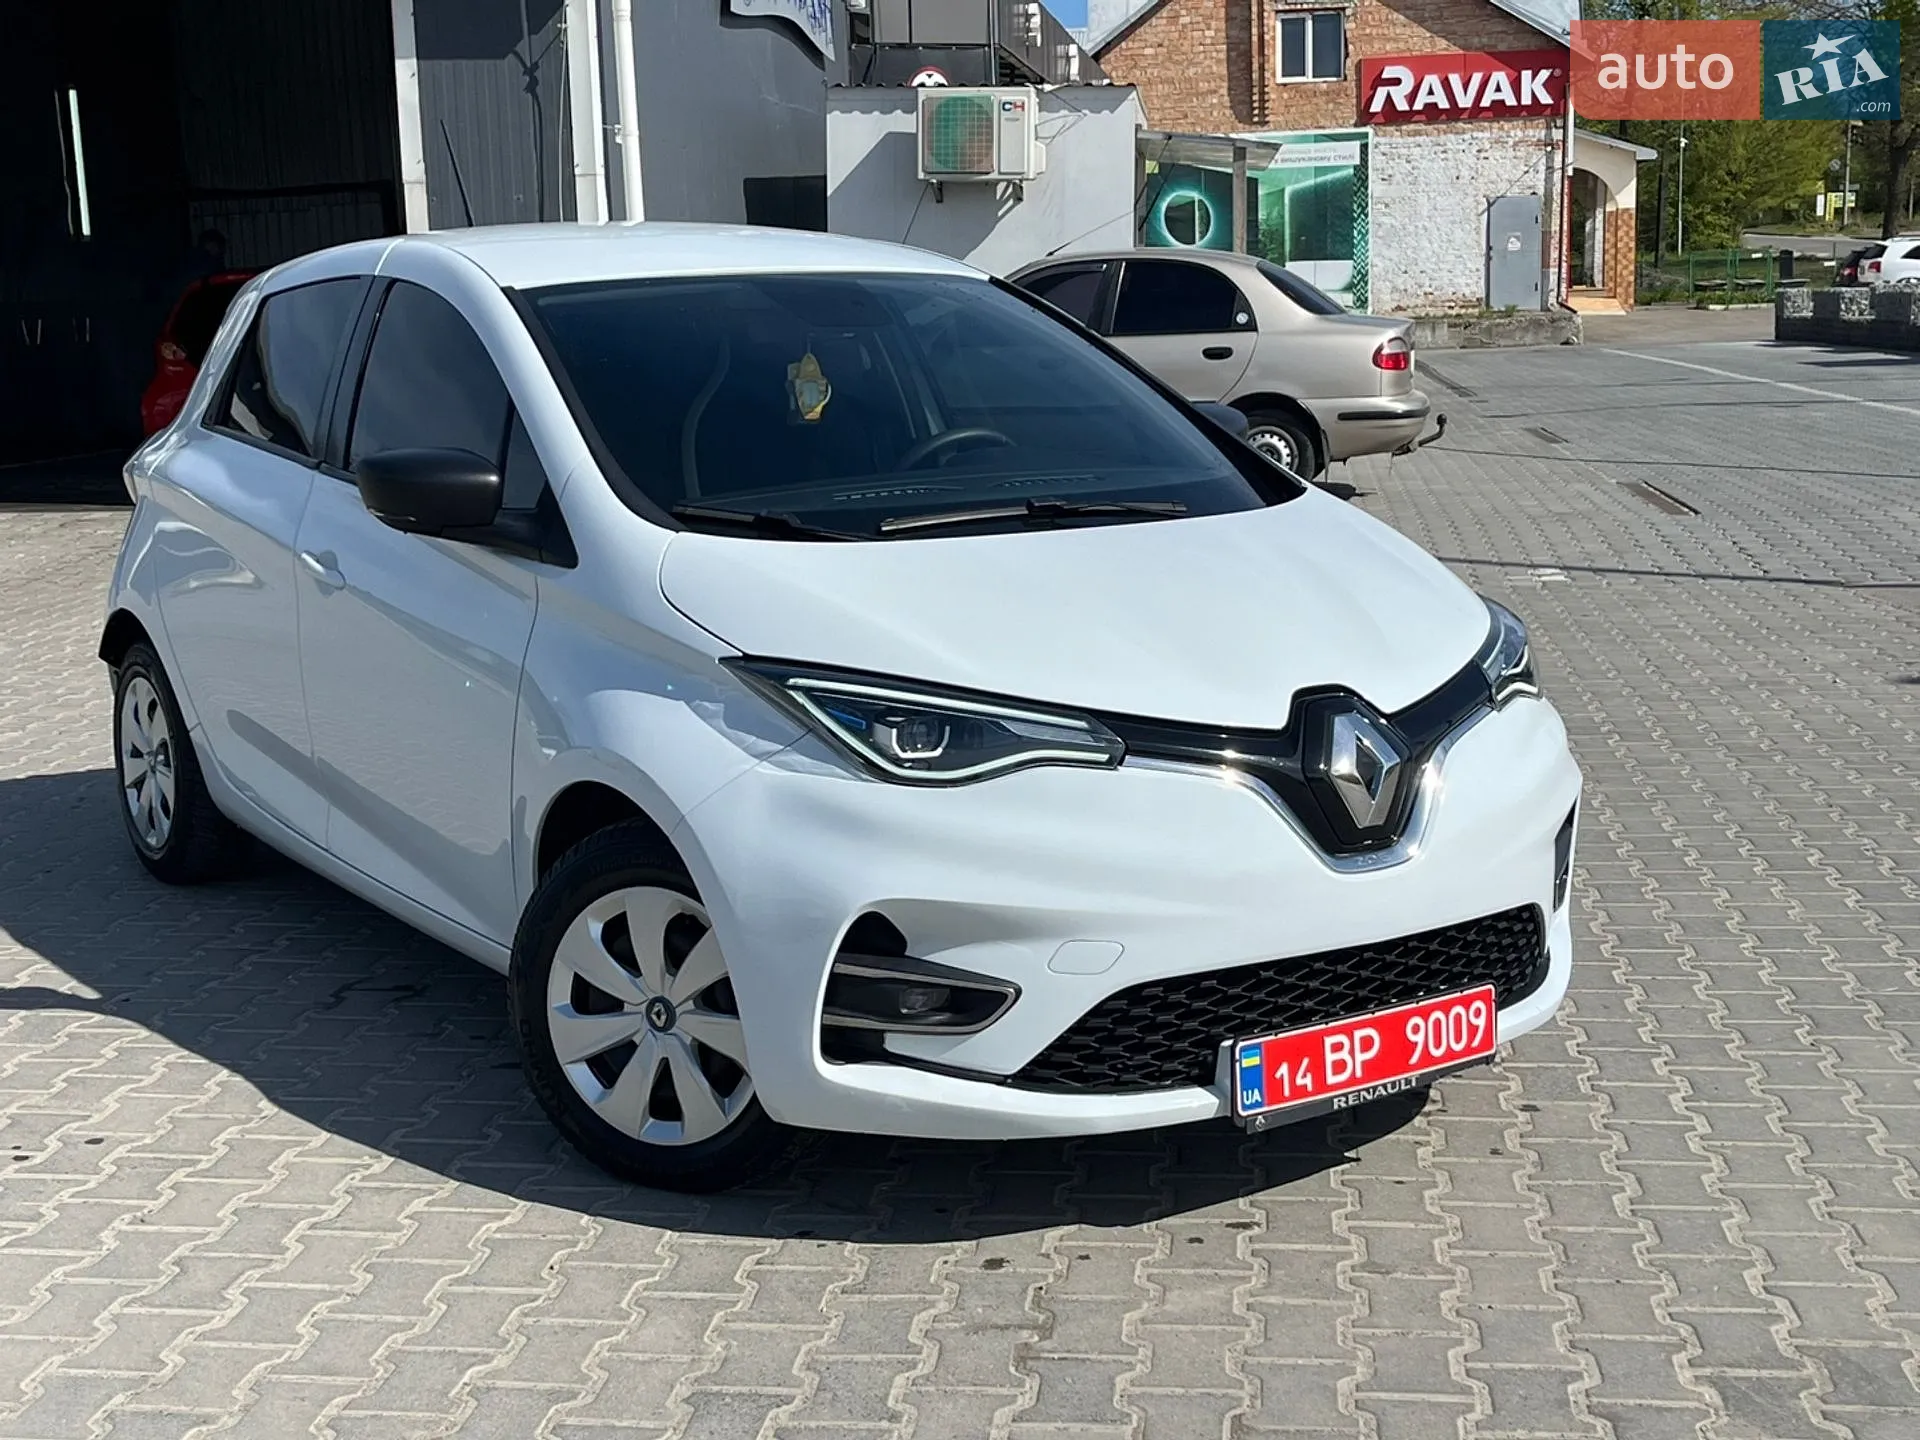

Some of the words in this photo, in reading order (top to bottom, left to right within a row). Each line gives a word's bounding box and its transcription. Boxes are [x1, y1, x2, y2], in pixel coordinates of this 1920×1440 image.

[1369, 65, 1554, 113] RAVAK
[1002, 101, 1025, 112] CH
[1274, 1057, 1313, 1097] 14
[1323, 1027, 1380, 1086] BP
[1405, 1000, 1487, 1065] 9009
[1243, 1089, 1262, 1105] UA
[1333, 1076, 1420, 1109] RENAULT
